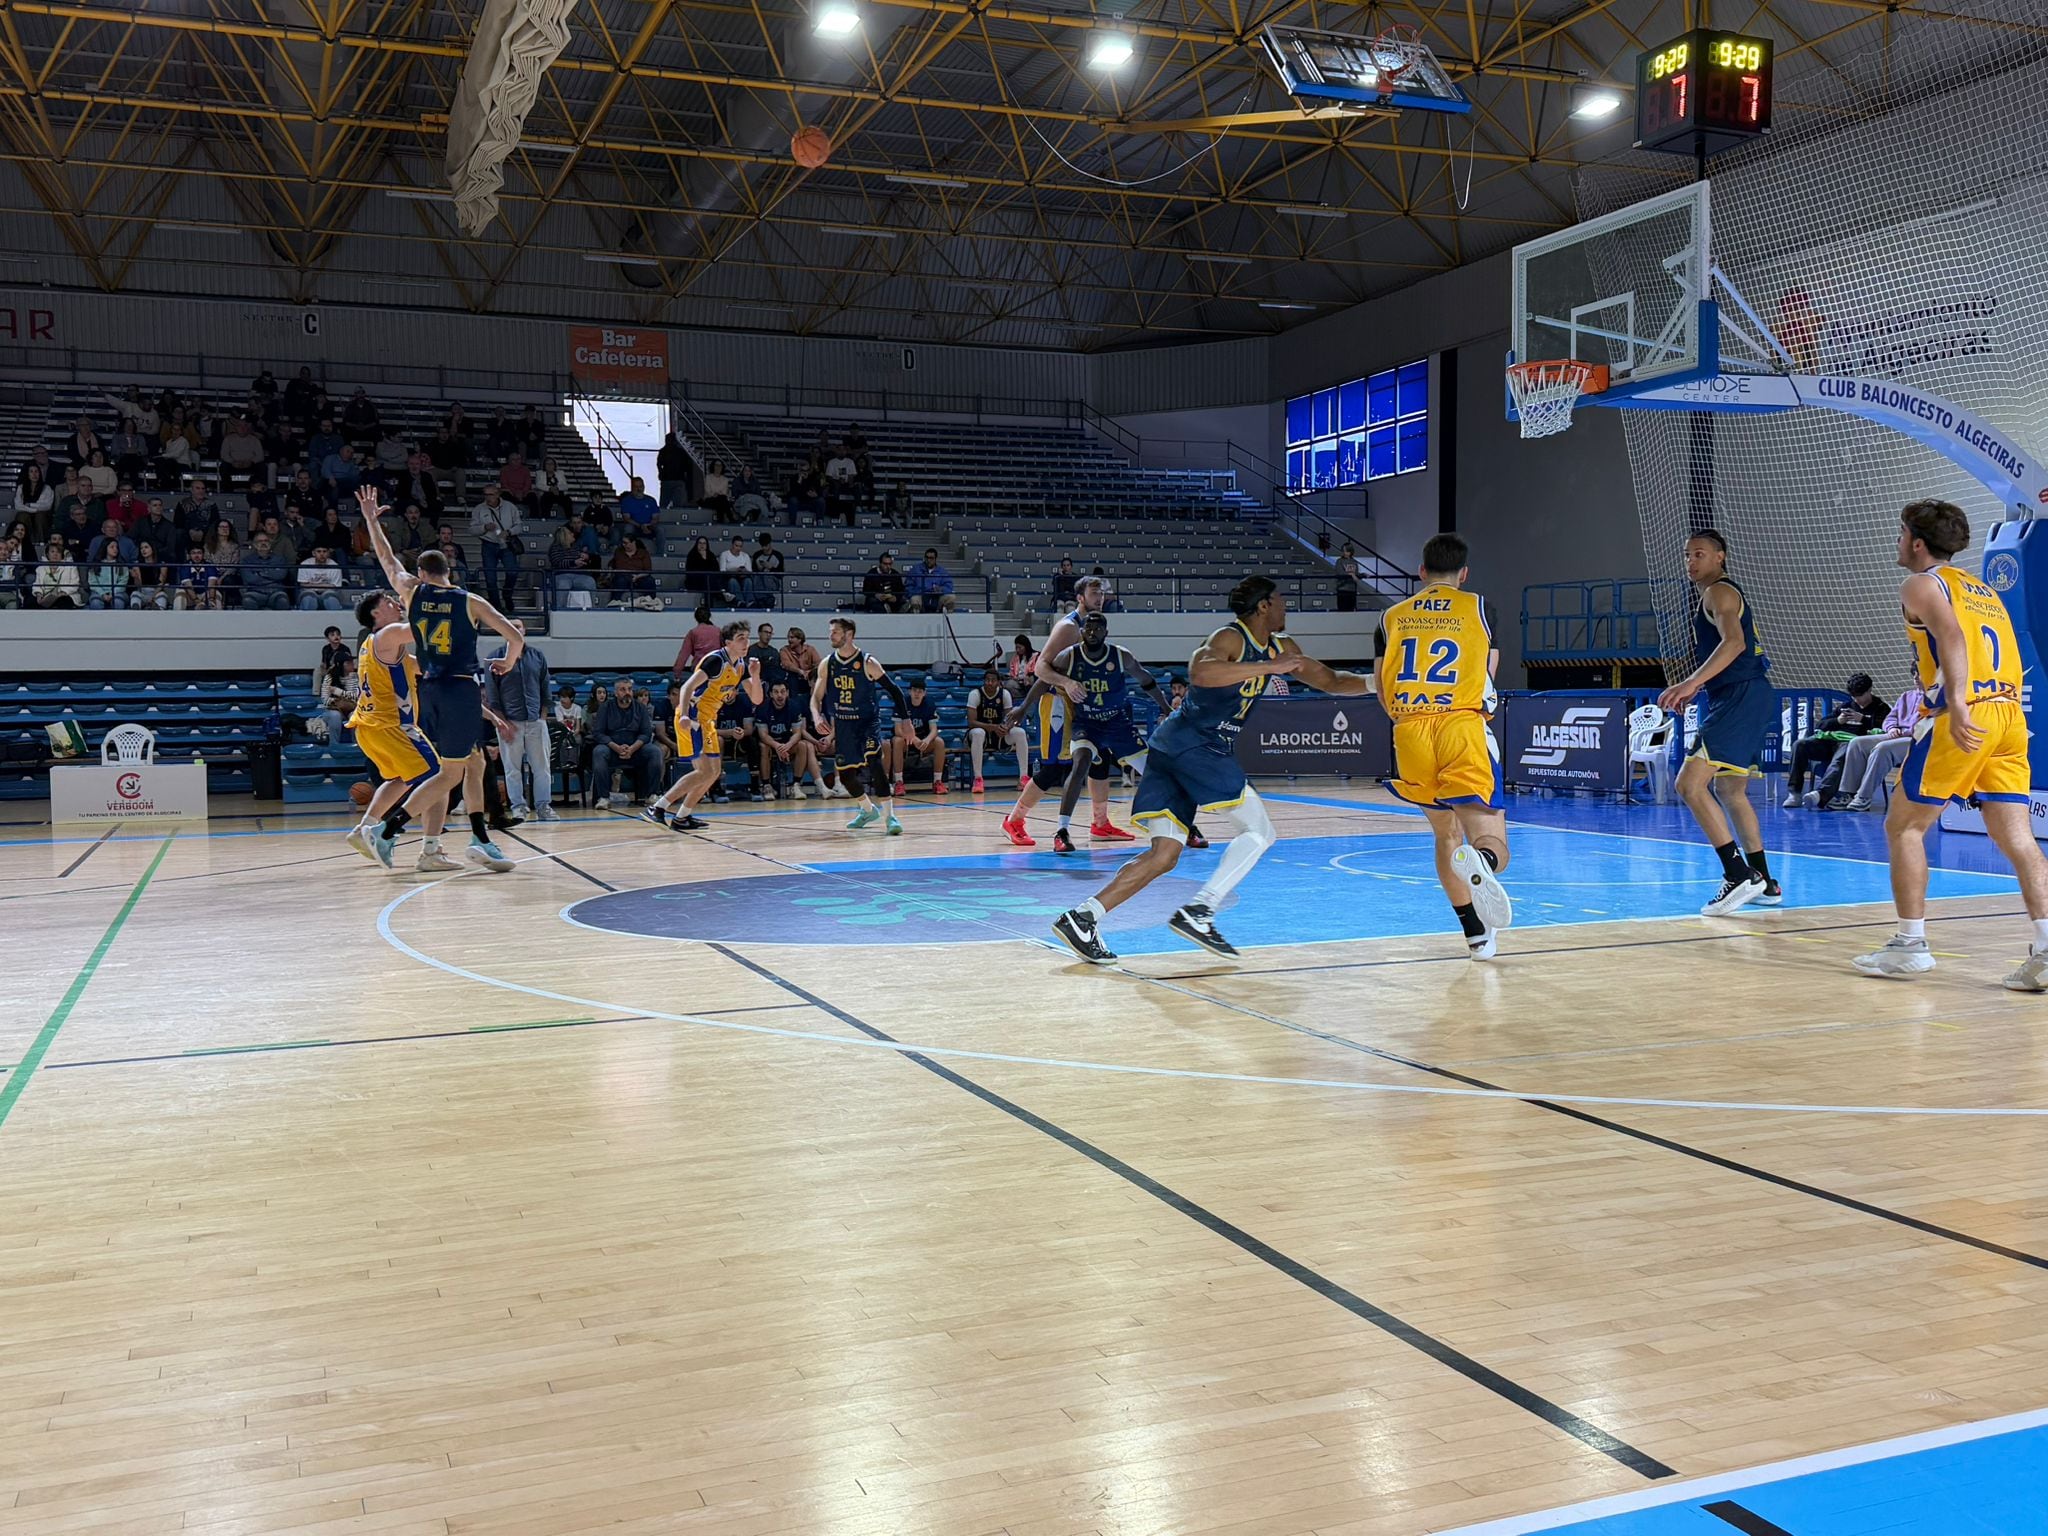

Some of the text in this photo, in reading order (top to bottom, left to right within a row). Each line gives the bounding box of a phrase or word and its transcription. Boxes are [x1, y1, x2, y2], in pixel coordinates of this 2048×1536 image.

[1654, 43, 1688, 79] 9:29
[1719, 42, 1761, 71] 9:29
[1671, 74, 1687, 118] 7
[1741, 76, 1760, 121] 7
[304, 313, 318, 335] C
[601, 329, 636, 347] Bar
[903, 348, 915, 370] D
[1682, 393, 1740, 402] CENTER
[1818, 378, 2025, 479] CLUB BALONCESTO ALGECIRAS
[1413, 597, 1451, 611] PÁEZ
[1396, 617, 1462, 626] NOVASCHOOL
[416, 618, 452, 655] 14
[1396, 637, 1459, 685] 12
[834, 675, 855, 690] CBA
[1083, 678, 1110, 693] CBA
[839, 691, 852, 704] 22
[1093, 693, 1104, 706] 4
[1391, 691, 1454, 705] MAS
[1260, 732, 1362, 746] LABORCLEAN
[1532, 725, 1601, 749] ALGESUR
[1528, 768, 1600, 779] REPUESTOS DEL AUTOMÓVIL
[107, 800, 154, 811] VERBOOM
